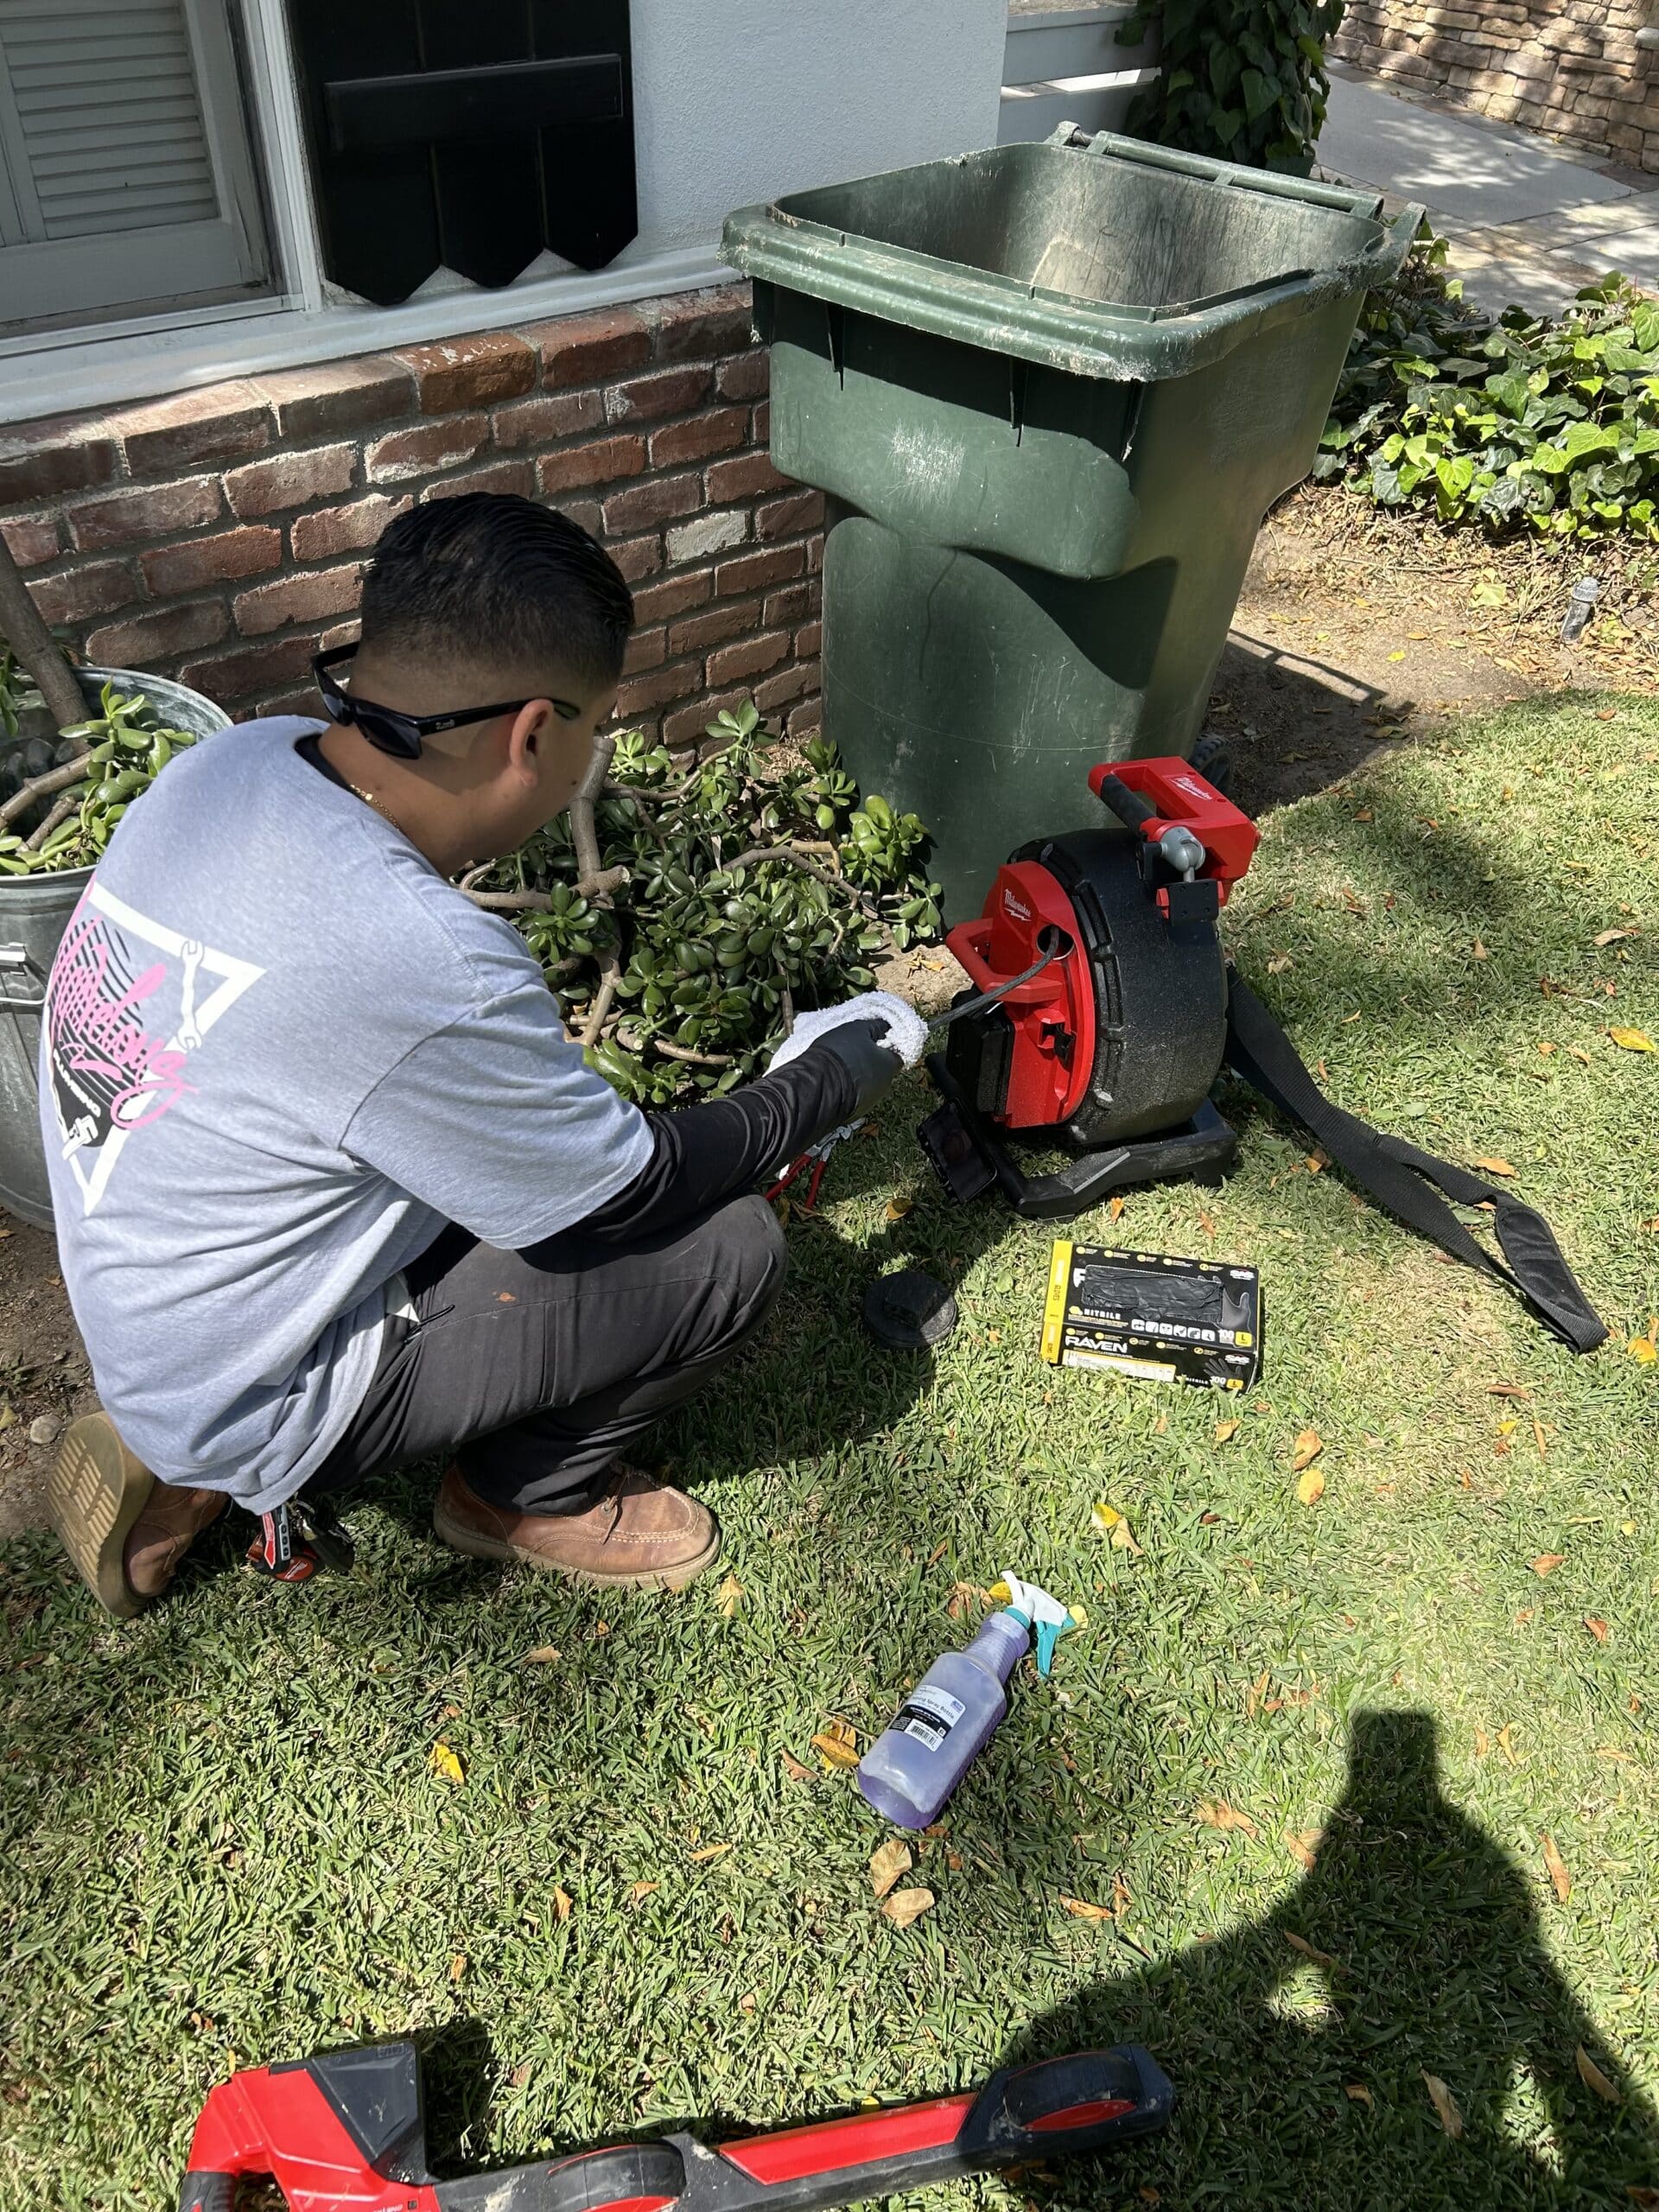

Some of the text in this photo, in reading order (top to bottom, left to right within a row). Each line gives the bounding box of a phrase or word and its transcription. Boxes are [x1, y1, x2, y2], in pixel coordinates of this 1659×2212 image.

[1175, 777, 1212, 800] Milwaukee
[1005, 888, 1031, 918] Milwaukee
[1084, 1308, 1121, 1320] NITRILE
[1065, 1335, 1128, 1354] RAVEN
